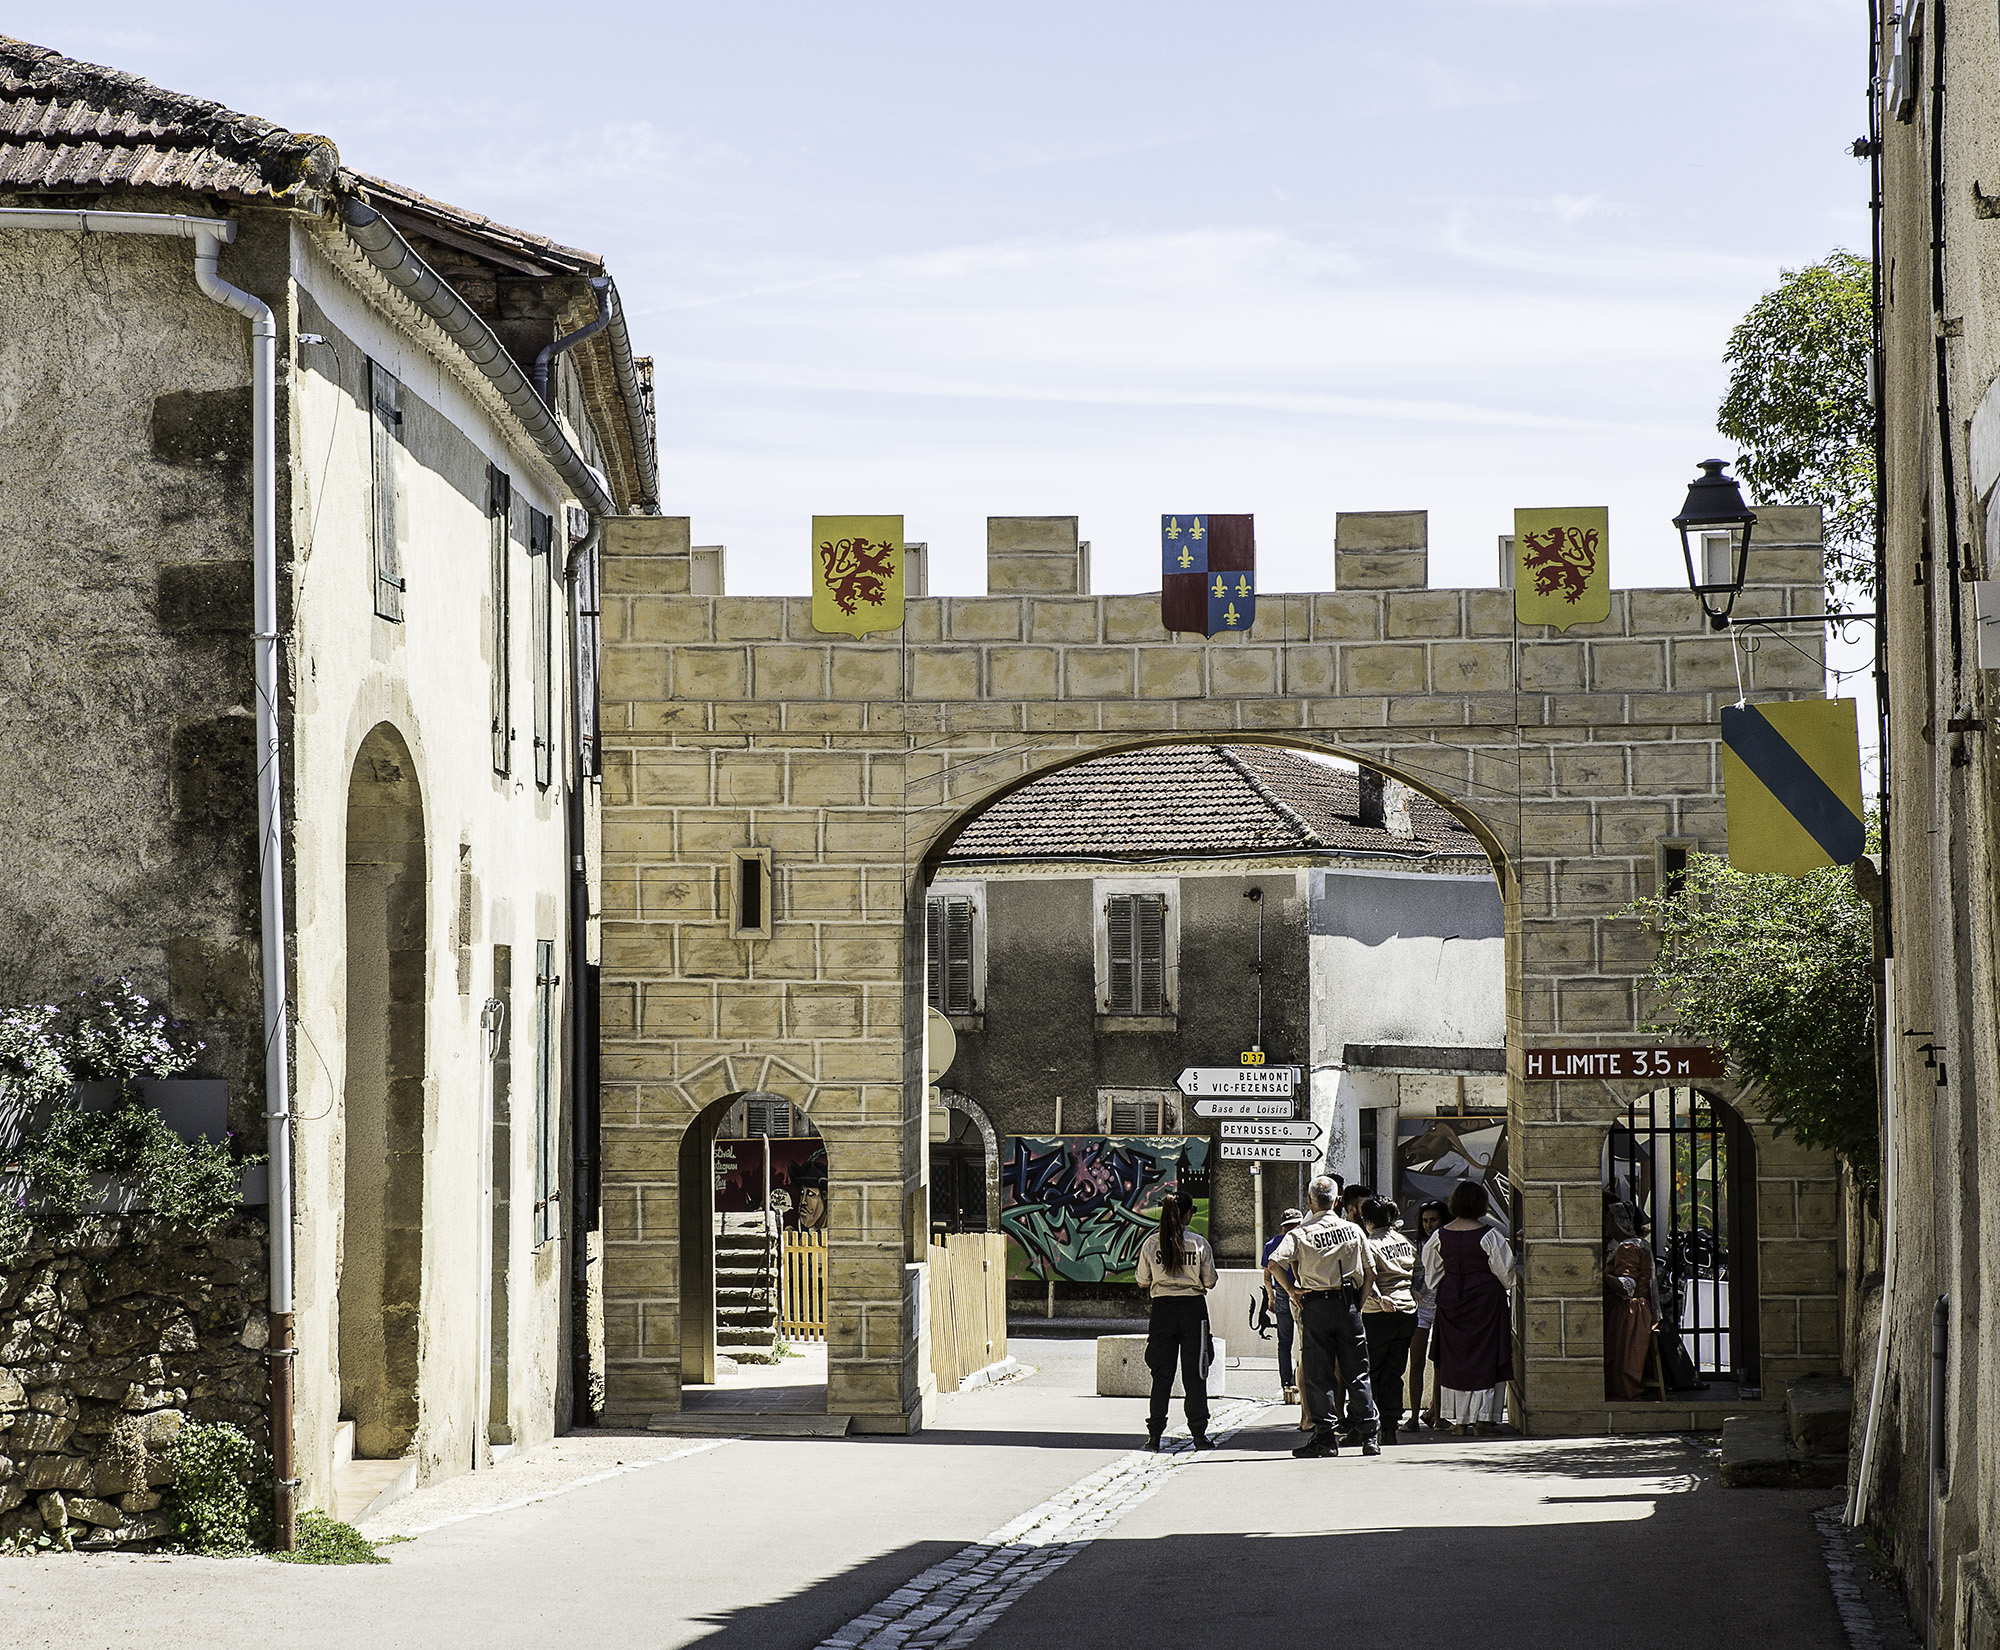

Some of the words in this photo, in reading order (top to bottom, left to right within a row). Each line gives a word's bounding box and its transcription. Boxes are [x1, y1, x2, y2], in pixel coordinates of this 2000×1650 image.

[1242, 1054, 1249, 1063] D
[1251, 1054, 1264, 1063] 37
[1528, 1054, 1543, 1075] H
[1552, 1054, 1621, 1075] LIMITE
[1632, 1051, 1671, 1077] 3,5
[1192, 1072, 1199, 1080] 5
[1239, 1072, 1289, 1081] BELMONT
[1188, 1083, 1199, 1092] 15
[1212, 1083, 1289, 1092] VIC-FEZENSAC
[1211, 1104, 1234, 1114] Base
[1239, 1104, 1251, 1114] de
[1256, 1104, 1288, 1114] Loisirs
[1223, 1125, 1293, 1136] PEYRUSSE-G.
[1306, 1127, 1312, 1136] 7
[1223, 1146, 1281, 1157] PLAISANCE
[1301, 1149, 1312, 1158] 18
[1155, 1250, 1197, 1266] SITE
